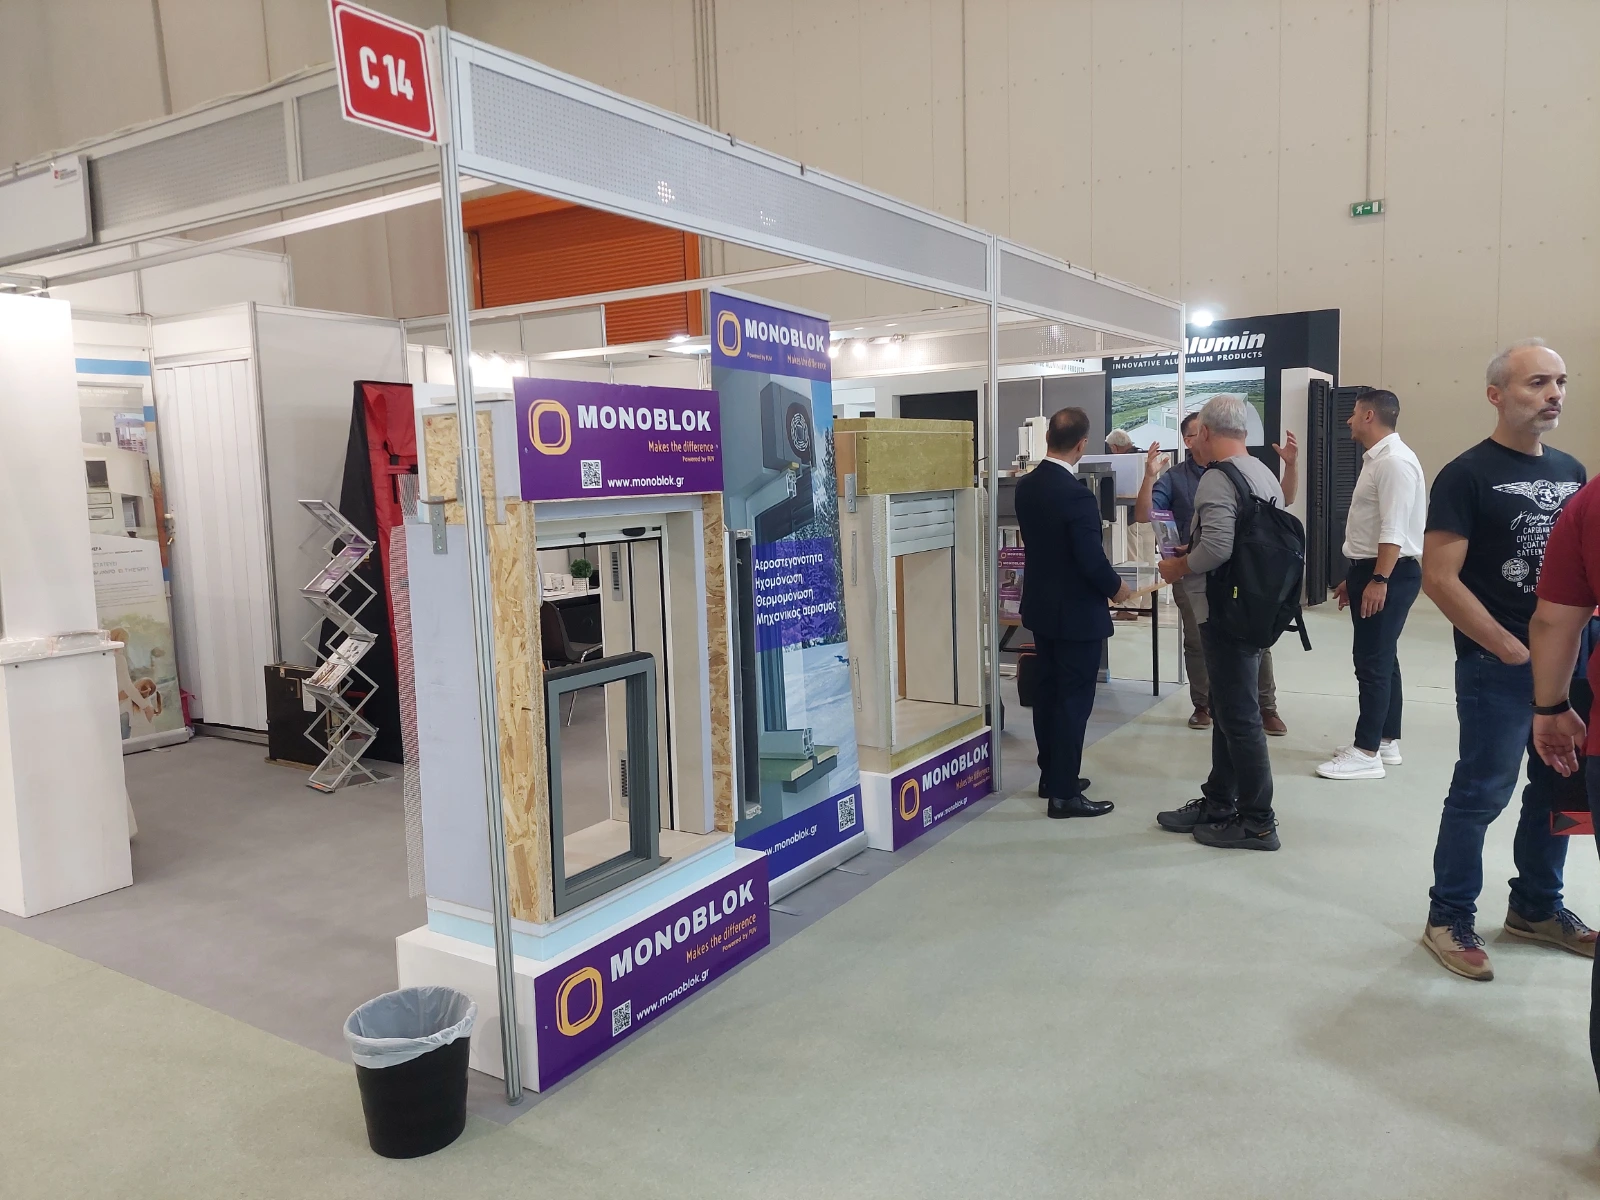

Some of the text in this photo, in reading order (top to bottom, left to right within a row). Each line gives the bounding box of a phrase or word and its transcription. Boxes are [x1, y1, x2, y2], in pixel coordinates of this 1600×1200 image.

[359, 45, 415, 101] C 14
[745, 318, 825, 353] MONOBLOK
[1112, 359, 1161, 370] INNOVATIVE
[1164, 355, 1213, 366] ALUINIUM
[1217, 351, 1263, 361] PRODUCTS
[577, 404, 712, 432] MONOBLOK
[648, 440, 714, 453] Makes the difference
[607, 475, 685, 489] www.monoblok.gr
[754, 552, 823, 572] Αεροστεγανότητα
[755, 573, 803, 591] Ηχομόνωση
[756, 589, 814, 608] Θερμομόνωση
[757, 599, 836, 626] Μηχανικός αερισμός
[922, 742, 989, 792] MONOBLOK
[764, 824, 817, 856] w.monoblok.gr
[610, 879, 754, 982] MONOBLOK
[686, 913, 757, 964] Makes the difference
[722, 935, 741, 952] Powered
[742, 932, 748, 940] by
[636, 967, 710, 1021] www.monoblok.gr
